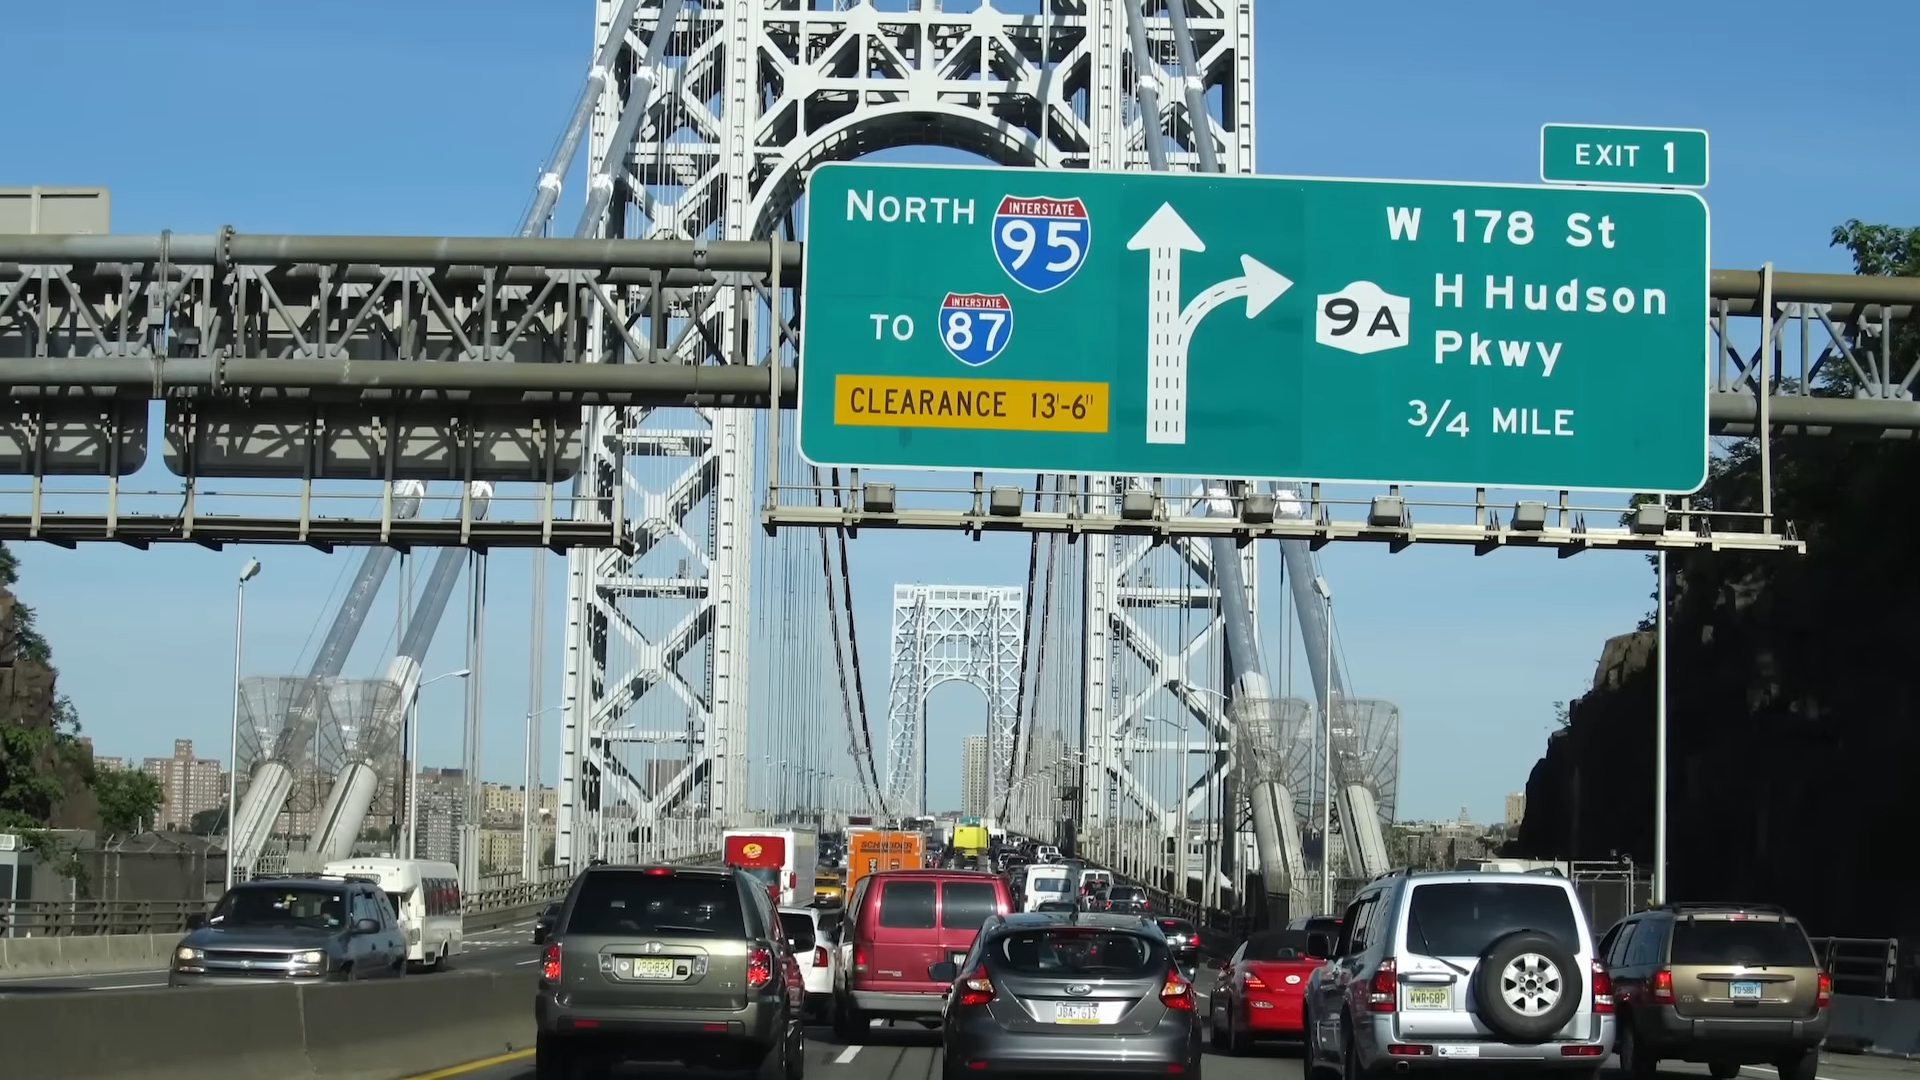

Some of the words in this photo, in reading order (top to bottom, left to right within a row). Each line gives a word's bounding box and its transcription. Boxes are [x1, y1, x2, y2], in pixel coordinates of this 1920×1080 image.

[1575, 143, 1640, 167] EXIT
[1663, 142, 1674, 173] 1
[846, 189, 975, 225] NORTH
[1008, 202, 1075, 217] INTERSTATE
[1001, 220, 1082, 272] 95
[1387, 206, 1422, 241] W
[1453, 209, 1535, 245] 178
[1566, 212, 1616, 249] St
[951, 297, 1002, 309] INTERSTATE
[1435, 273, 1463, 308] H
[1486, 275, 1667, 315] Hudson
[869, 314, 914, 341] TO
[946, 312, 1006, 352] 87
[1324, 298, 1401, 338] 9A
[1435, 330, 1562, 377] Pkwy
[850, 387, 1007, 417] CLEARANCE
[1407, 399, 1470, 438] 3/4
[1492, 407, 1574, 436] MILE
